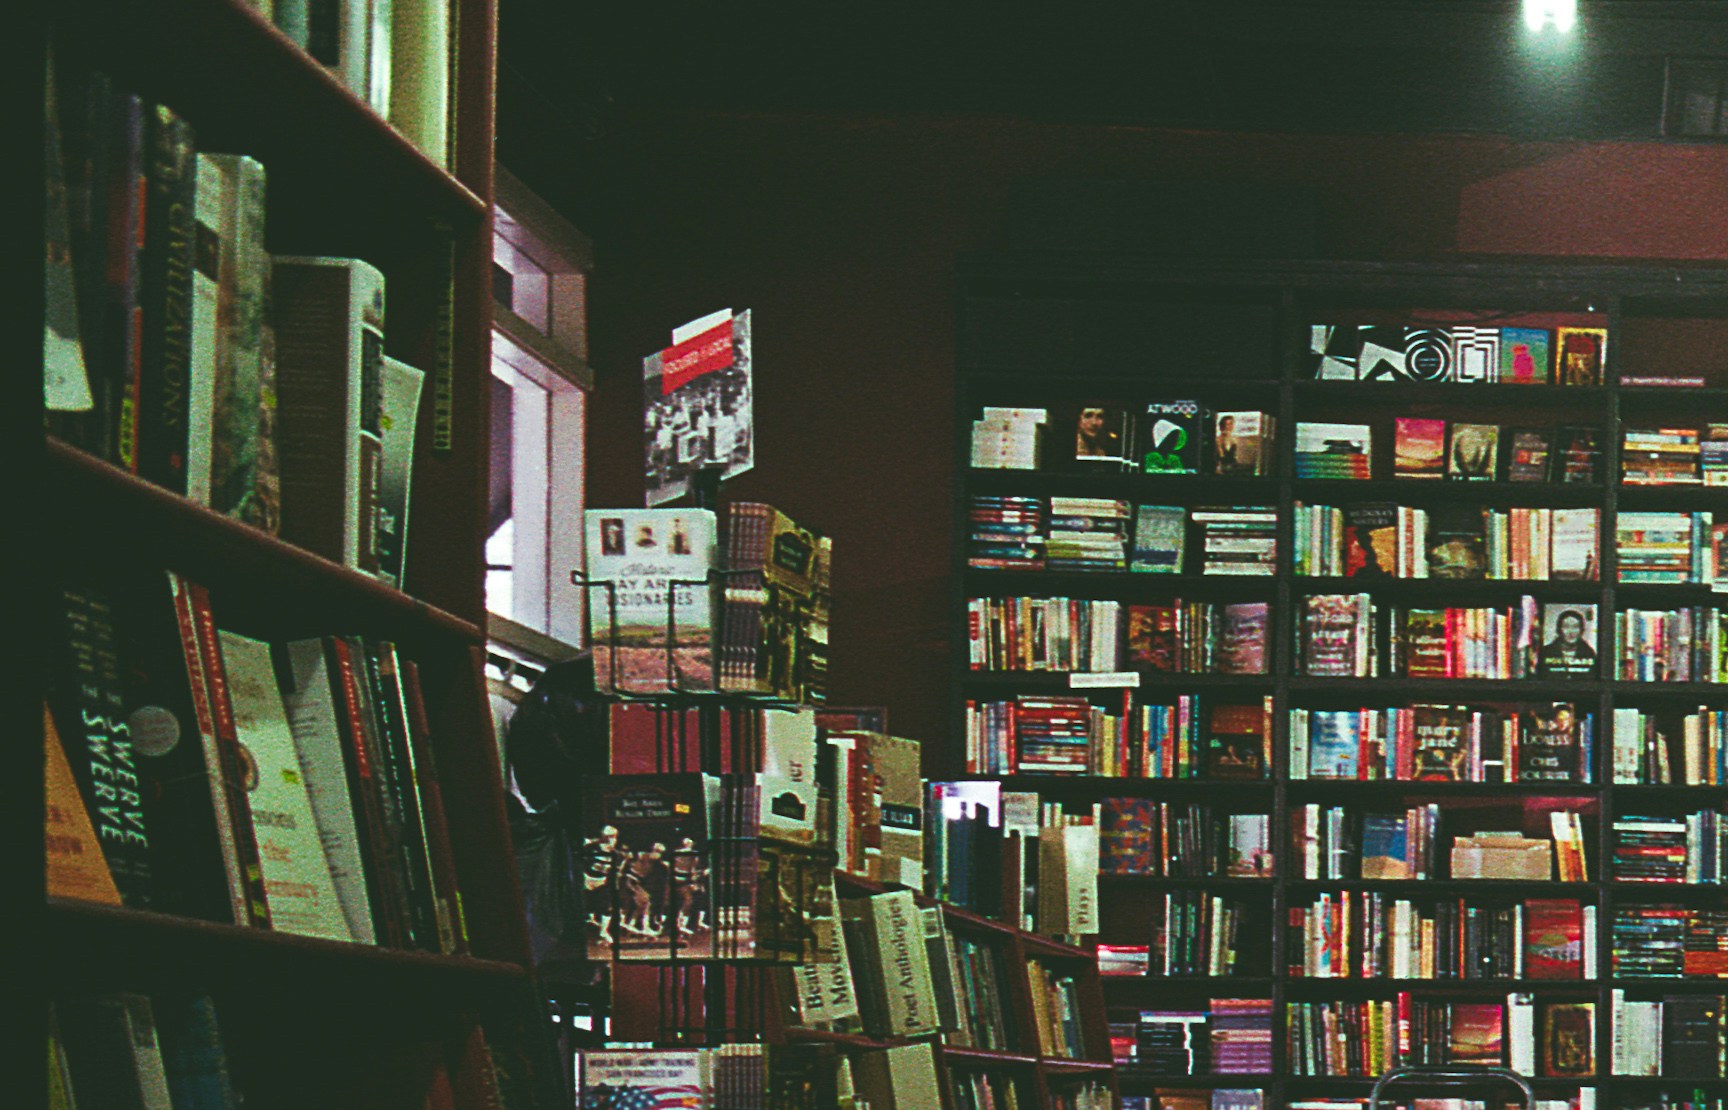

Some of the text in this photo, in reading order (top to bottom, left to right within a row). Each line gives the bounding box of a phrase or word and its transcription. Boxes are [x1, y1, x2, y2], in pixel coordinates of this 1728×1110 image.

[162, 200, 184, 430] CIVILIZATIONS
[82, 707, 123, 843] SWERVE
[106, 714, 149, 849] SWERVE
[890, 896, 922, 1029] Poet Anthologies
[1078, 888, 1089, 925] Plays
